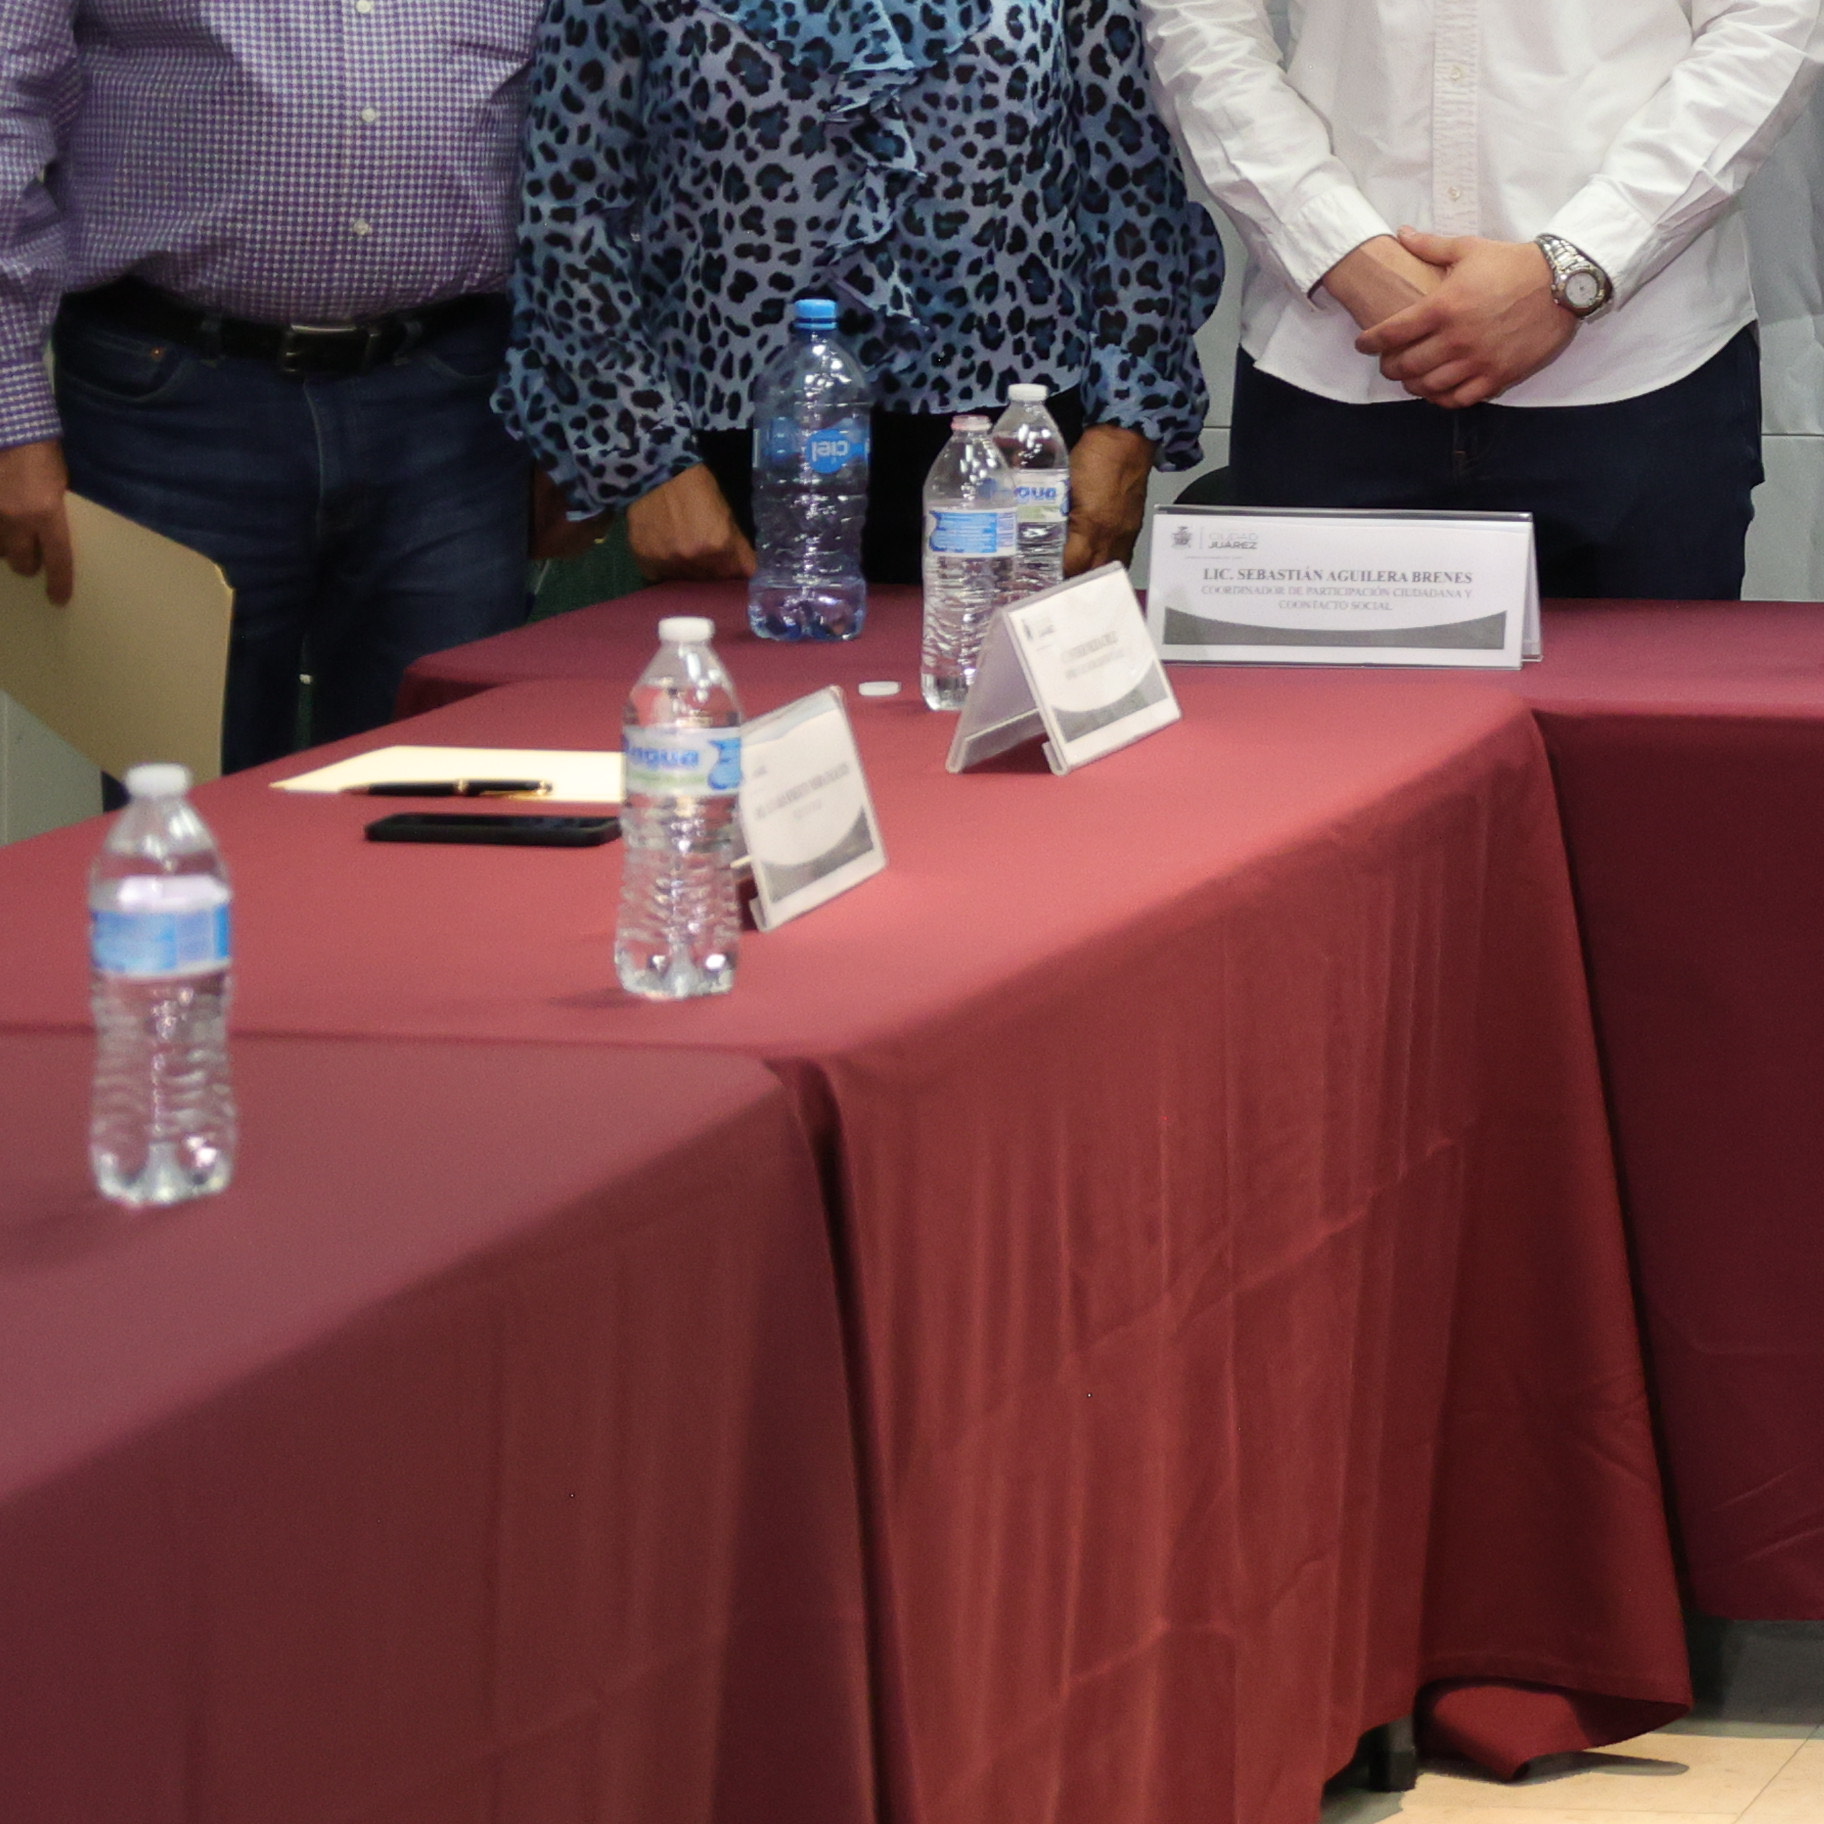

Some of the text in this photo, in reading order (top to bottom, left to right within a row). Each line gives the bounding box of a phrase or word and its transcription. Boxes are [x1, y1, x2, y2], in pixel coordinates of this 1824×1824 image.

[1207, 539, 1259, 550] JUÁREZ
[1202, 565, 1474, 586] LIC. SEBASTIÁN AGUILERA BRENES
[1287, 585, 1304, 597] DE
